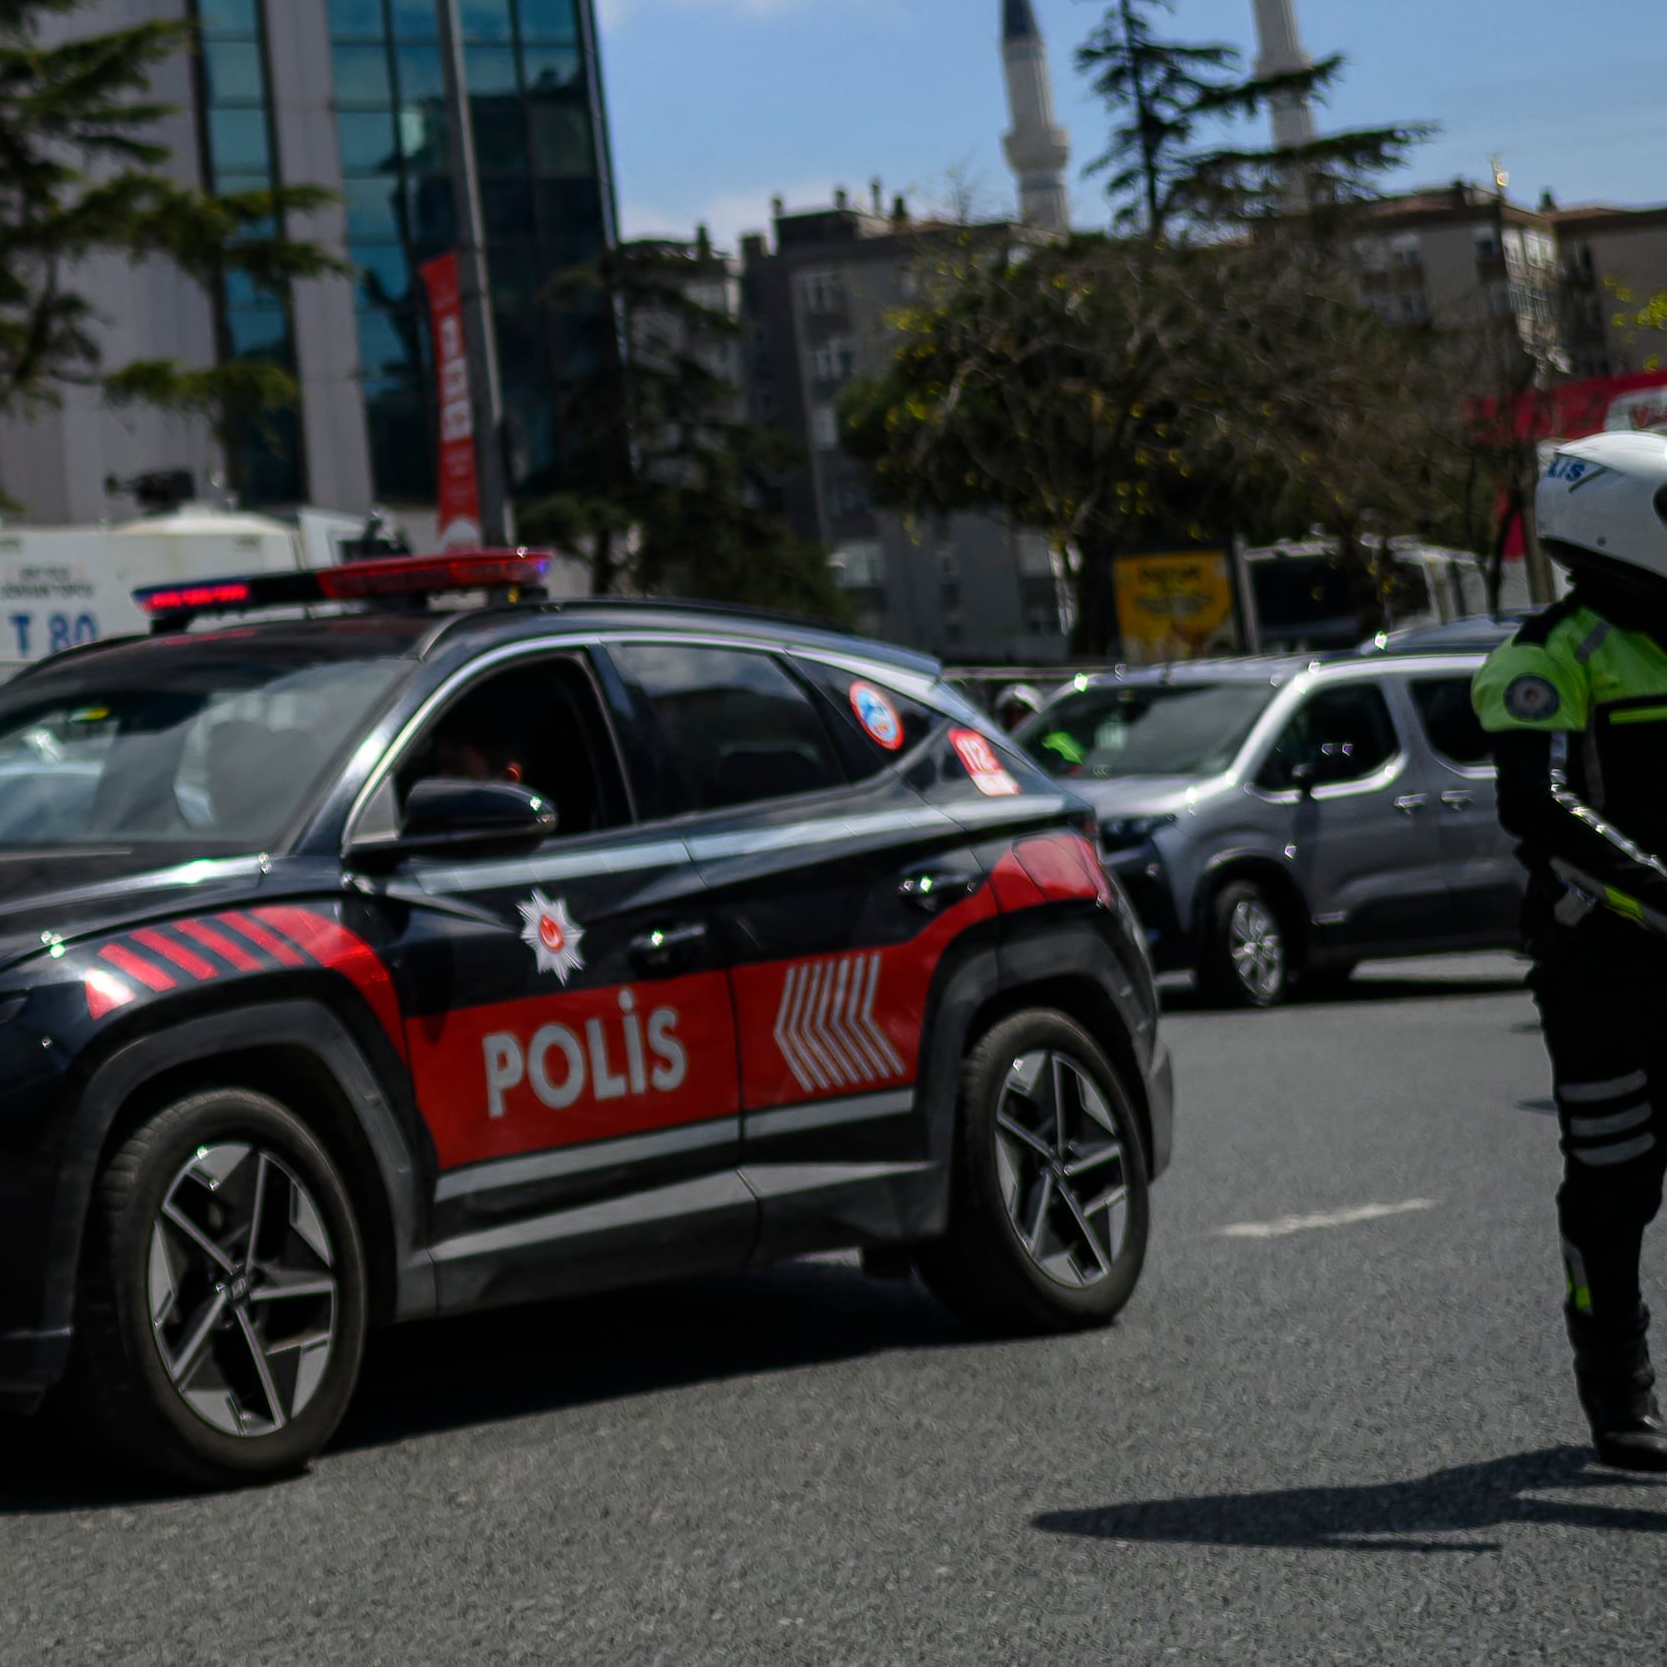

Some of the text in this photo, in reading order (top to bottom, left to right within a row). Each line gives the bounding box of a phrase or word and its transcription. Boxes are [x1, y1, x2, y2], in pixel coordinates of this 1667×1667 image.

[10, 614, 97, 654] T 80
[481, 988, 687, 1119] POLİS
